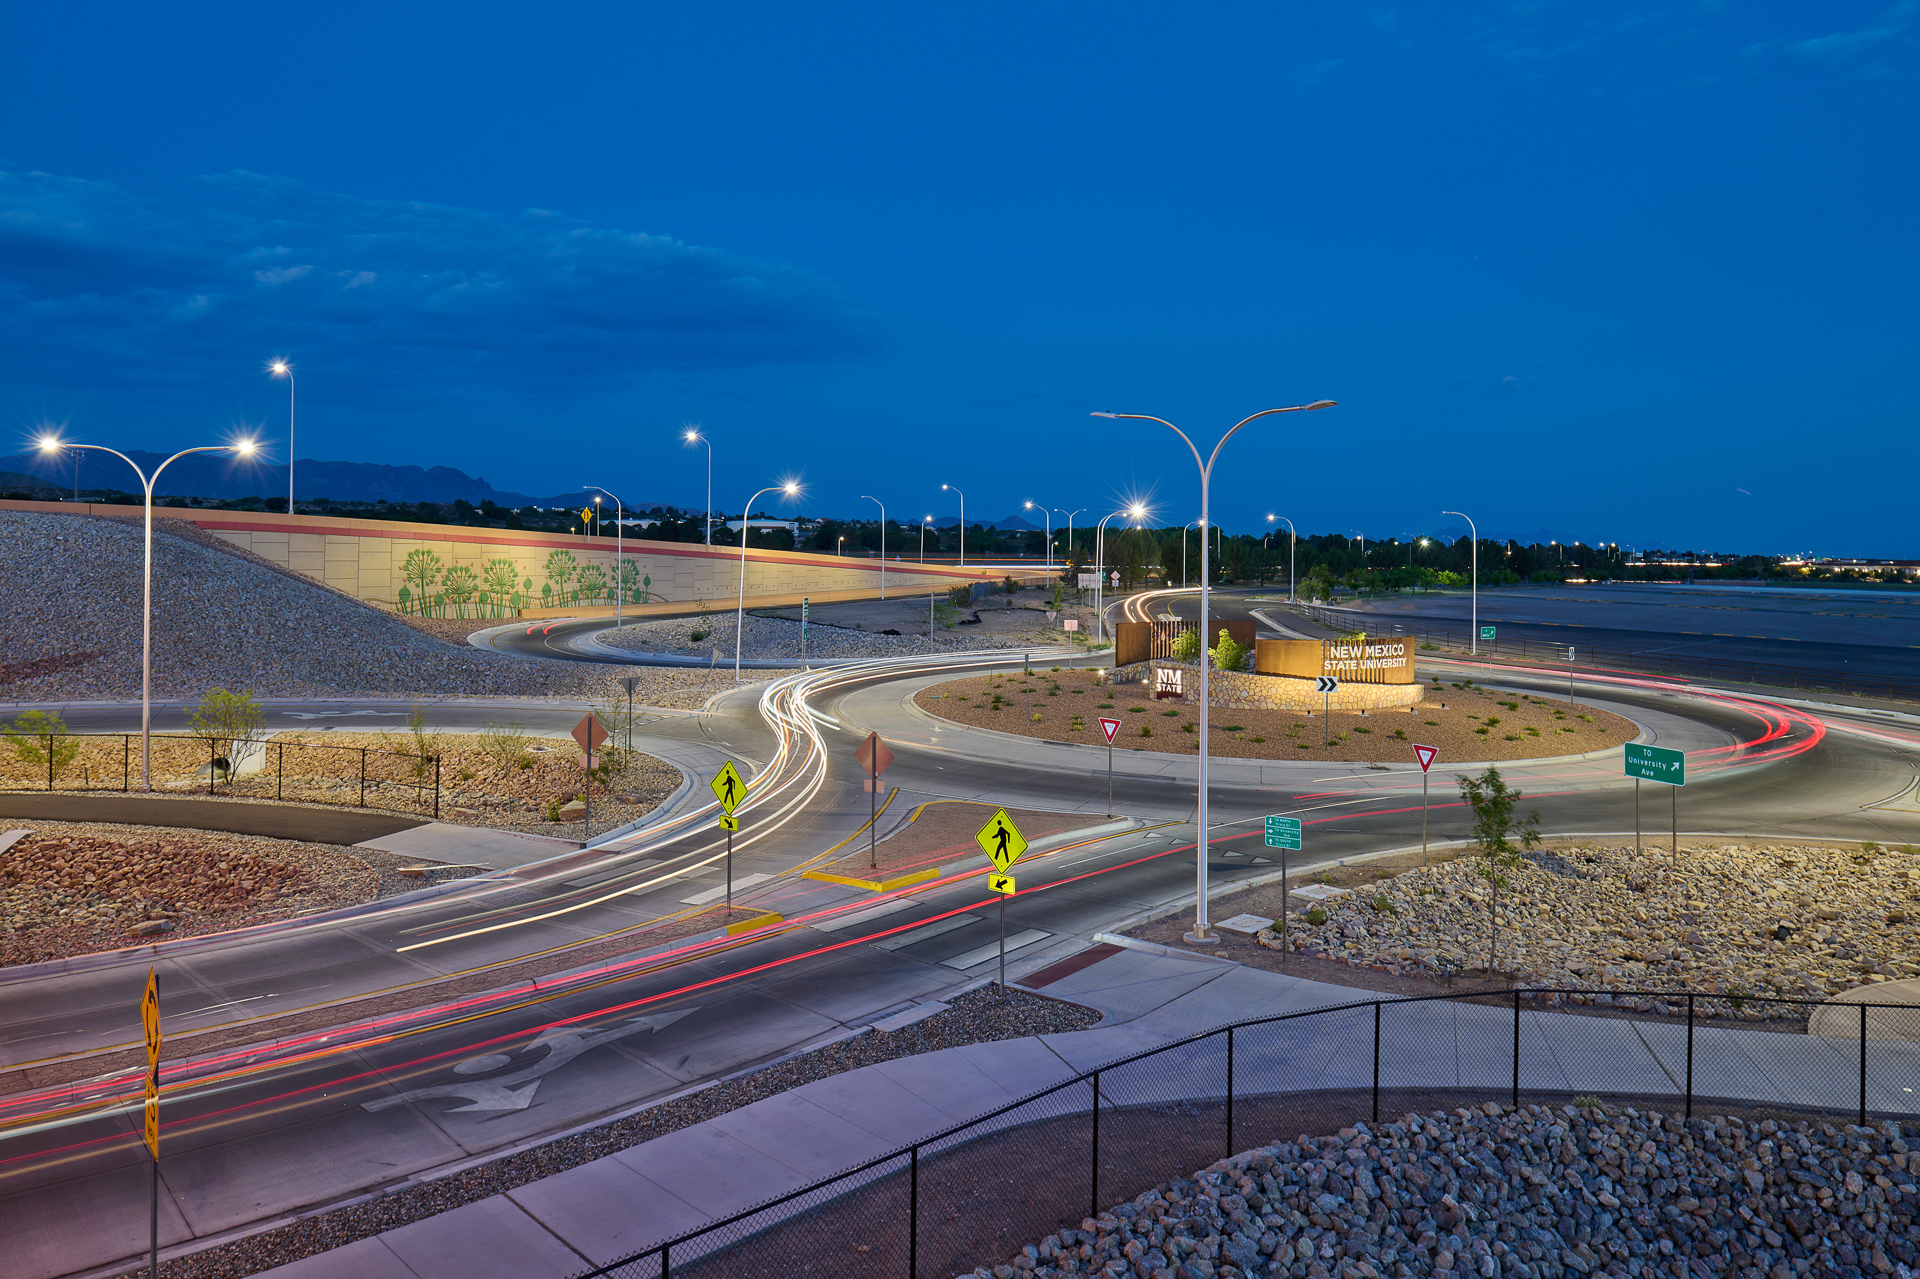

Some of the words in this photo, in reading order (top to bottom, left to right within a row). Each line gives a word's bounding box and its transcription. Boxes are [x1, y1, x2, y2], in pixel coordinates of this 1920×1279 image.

[1330, 645, 1362, 658] NEW
[1365, 643, 1404, 657] MEXICO
[1324, 660, 1357, 670] STATE
[1360, 657, 1406, 669] UNIVERSITY
[1157, 668, 1182, 684] NM
[1156, 684, 1182, 693] STATE
[1643, 749, 1652, 757] TO
[1629, 756, 1666, 770] University
[1641, 768, 1654, 776] Ave
